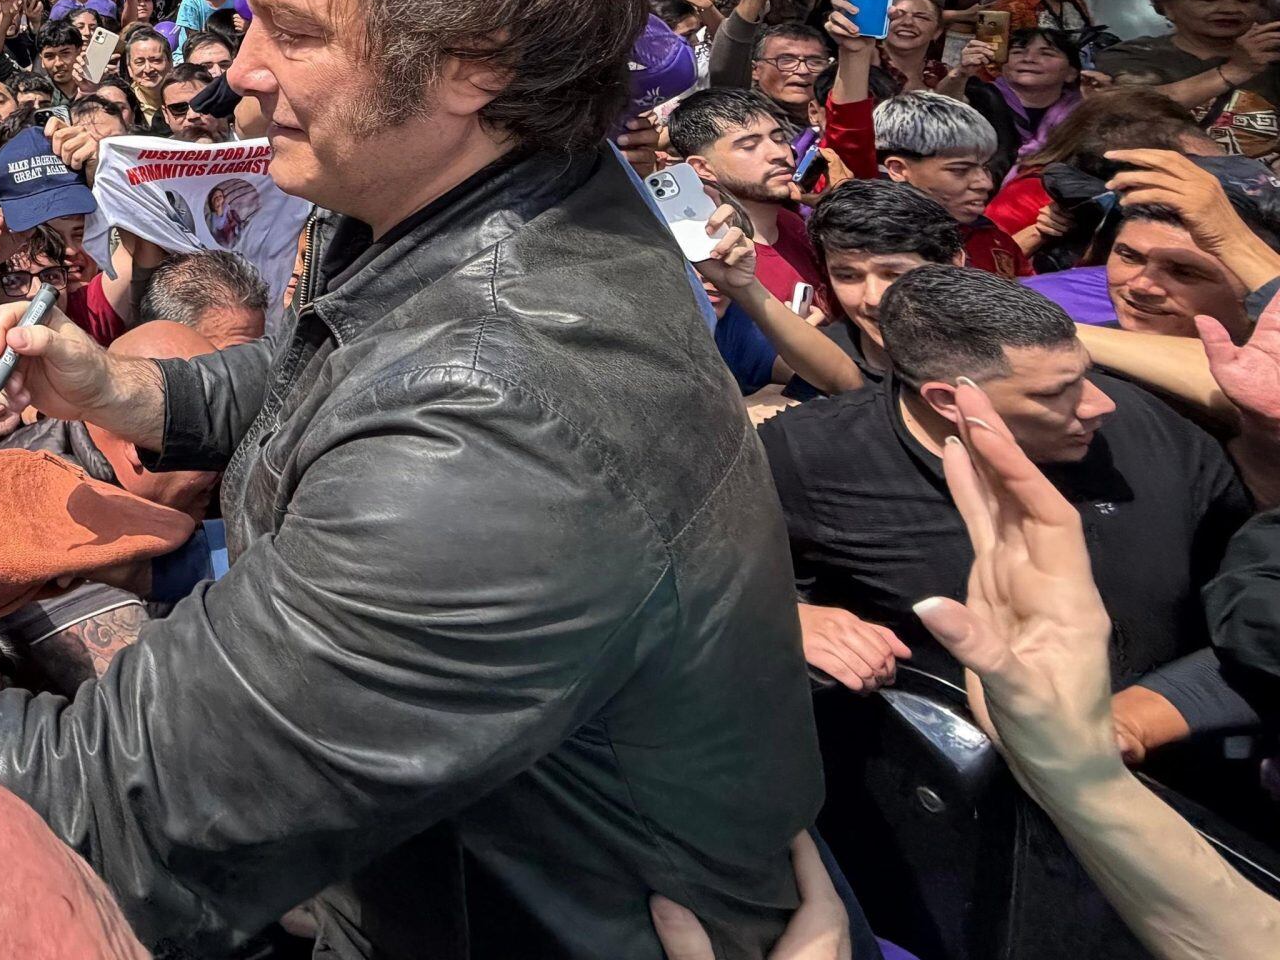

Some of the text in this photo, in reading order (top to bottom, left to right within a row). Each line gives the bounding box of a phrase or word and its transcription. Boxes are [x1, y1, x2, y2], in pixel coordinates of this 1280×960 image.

[137, 145, 271, 161] JUSTICIA POR LOS
[8, 159, 29, 173] MAKE
[14, 165, 68, 183] GREAT AGAIN
[207, 158, 270, 176] ALAGAST
